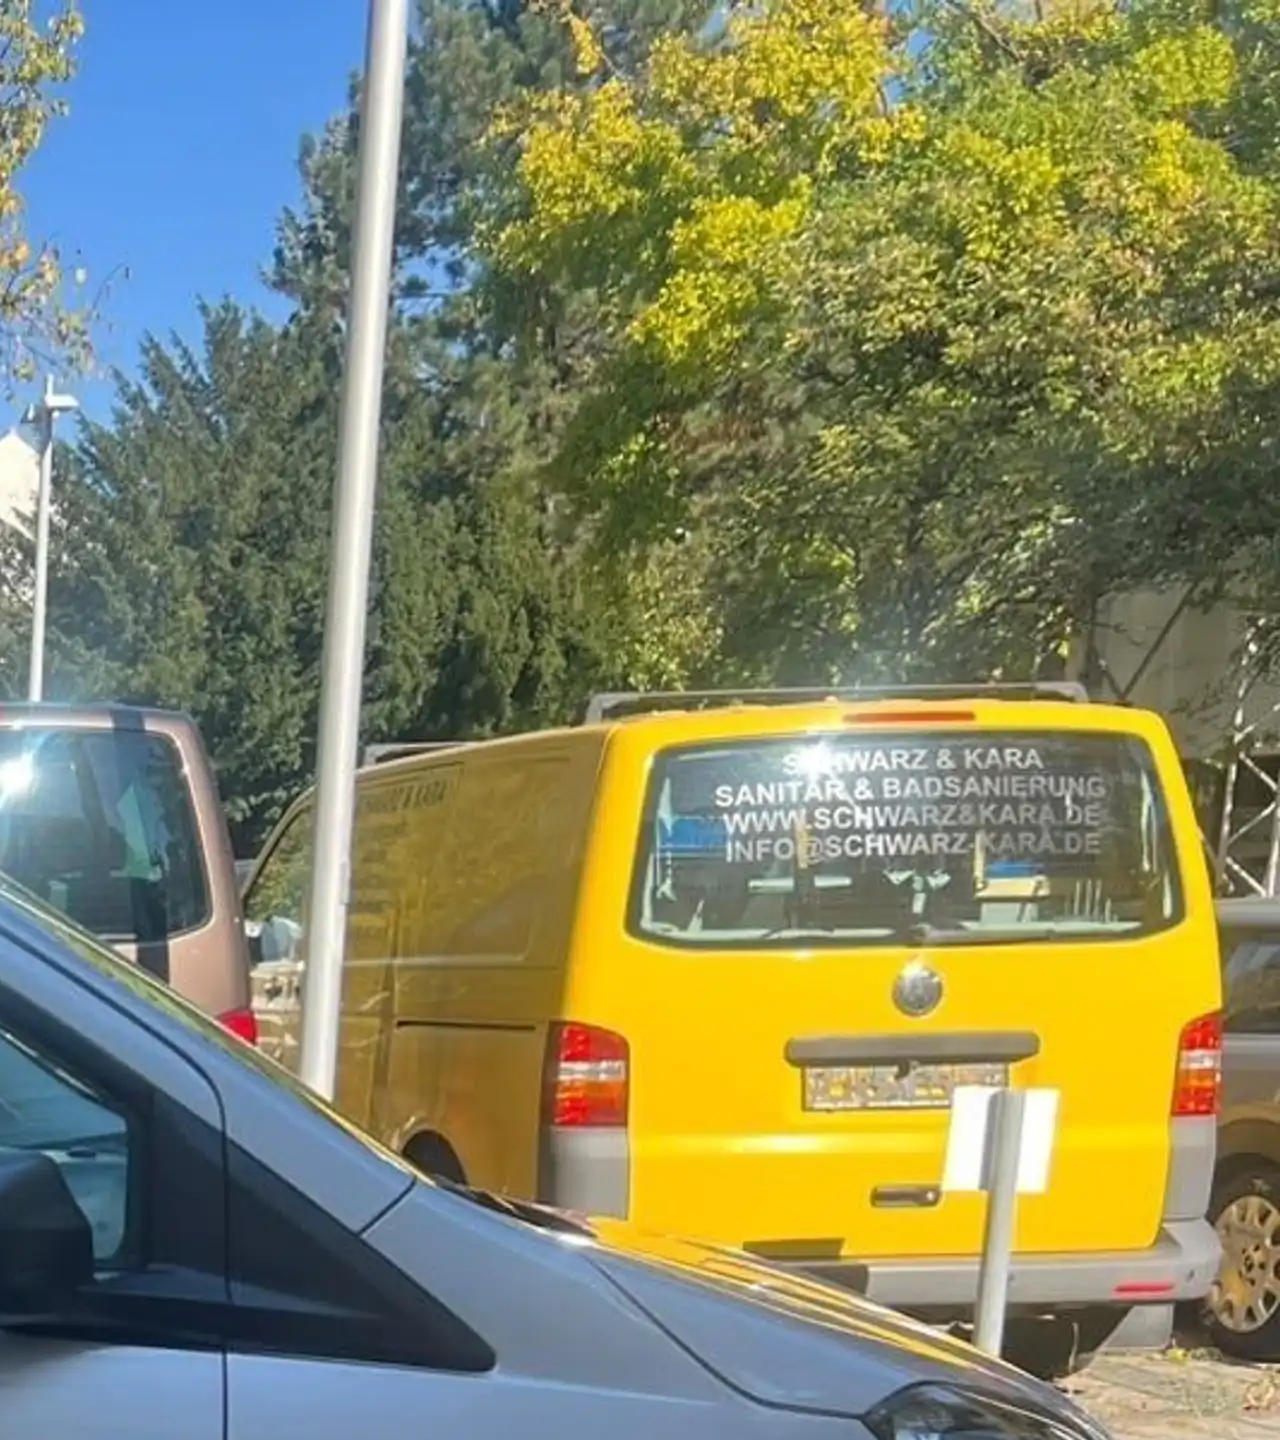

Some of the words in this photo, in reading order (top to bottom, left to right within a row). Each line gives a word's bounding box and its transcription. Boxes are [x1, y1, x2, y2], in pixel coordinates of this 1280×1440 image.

[782, 748, 929, 775] SHWARZ
[936, 748, 957, 770] &
[964, 747, 1044, 770] KARA
[854, 776, 874, 801] &
[883, 774, 1106, 800] BADSANIERUNG
